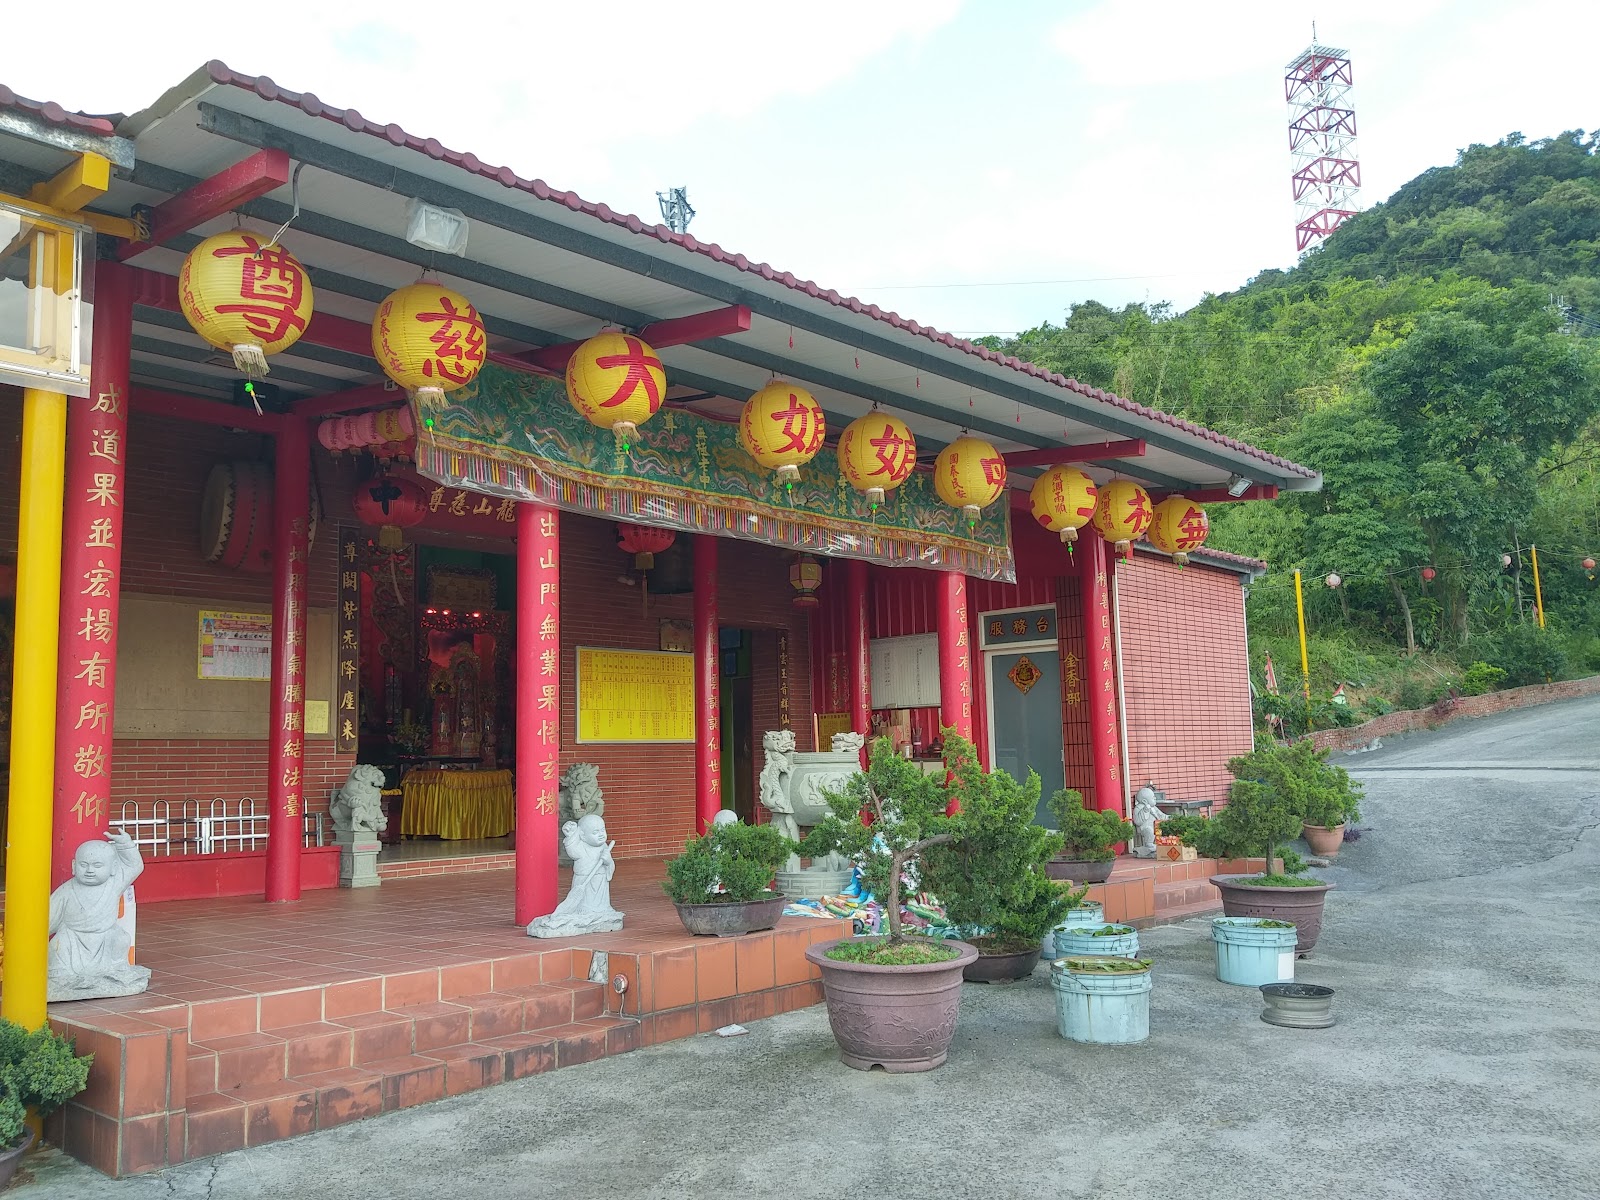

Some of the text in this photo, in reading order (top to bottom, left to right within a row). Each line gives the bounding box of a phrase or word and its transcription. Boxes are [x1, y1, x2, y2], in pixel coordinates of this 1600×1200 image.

[213, 235, 307, 344] 尊
[416, 296, 487, 385] 慈
[596, 337, 664, 414] 大
[949, 453, 967, 500] 國泰民安
[1176, 506, 1210, 550] 無
[70, 382, 126, 827] 成道果並宏揚有所敬仰
[989, 616, 1049, 637] 服務台
[1063, 651, 1081, 708] 金香部
